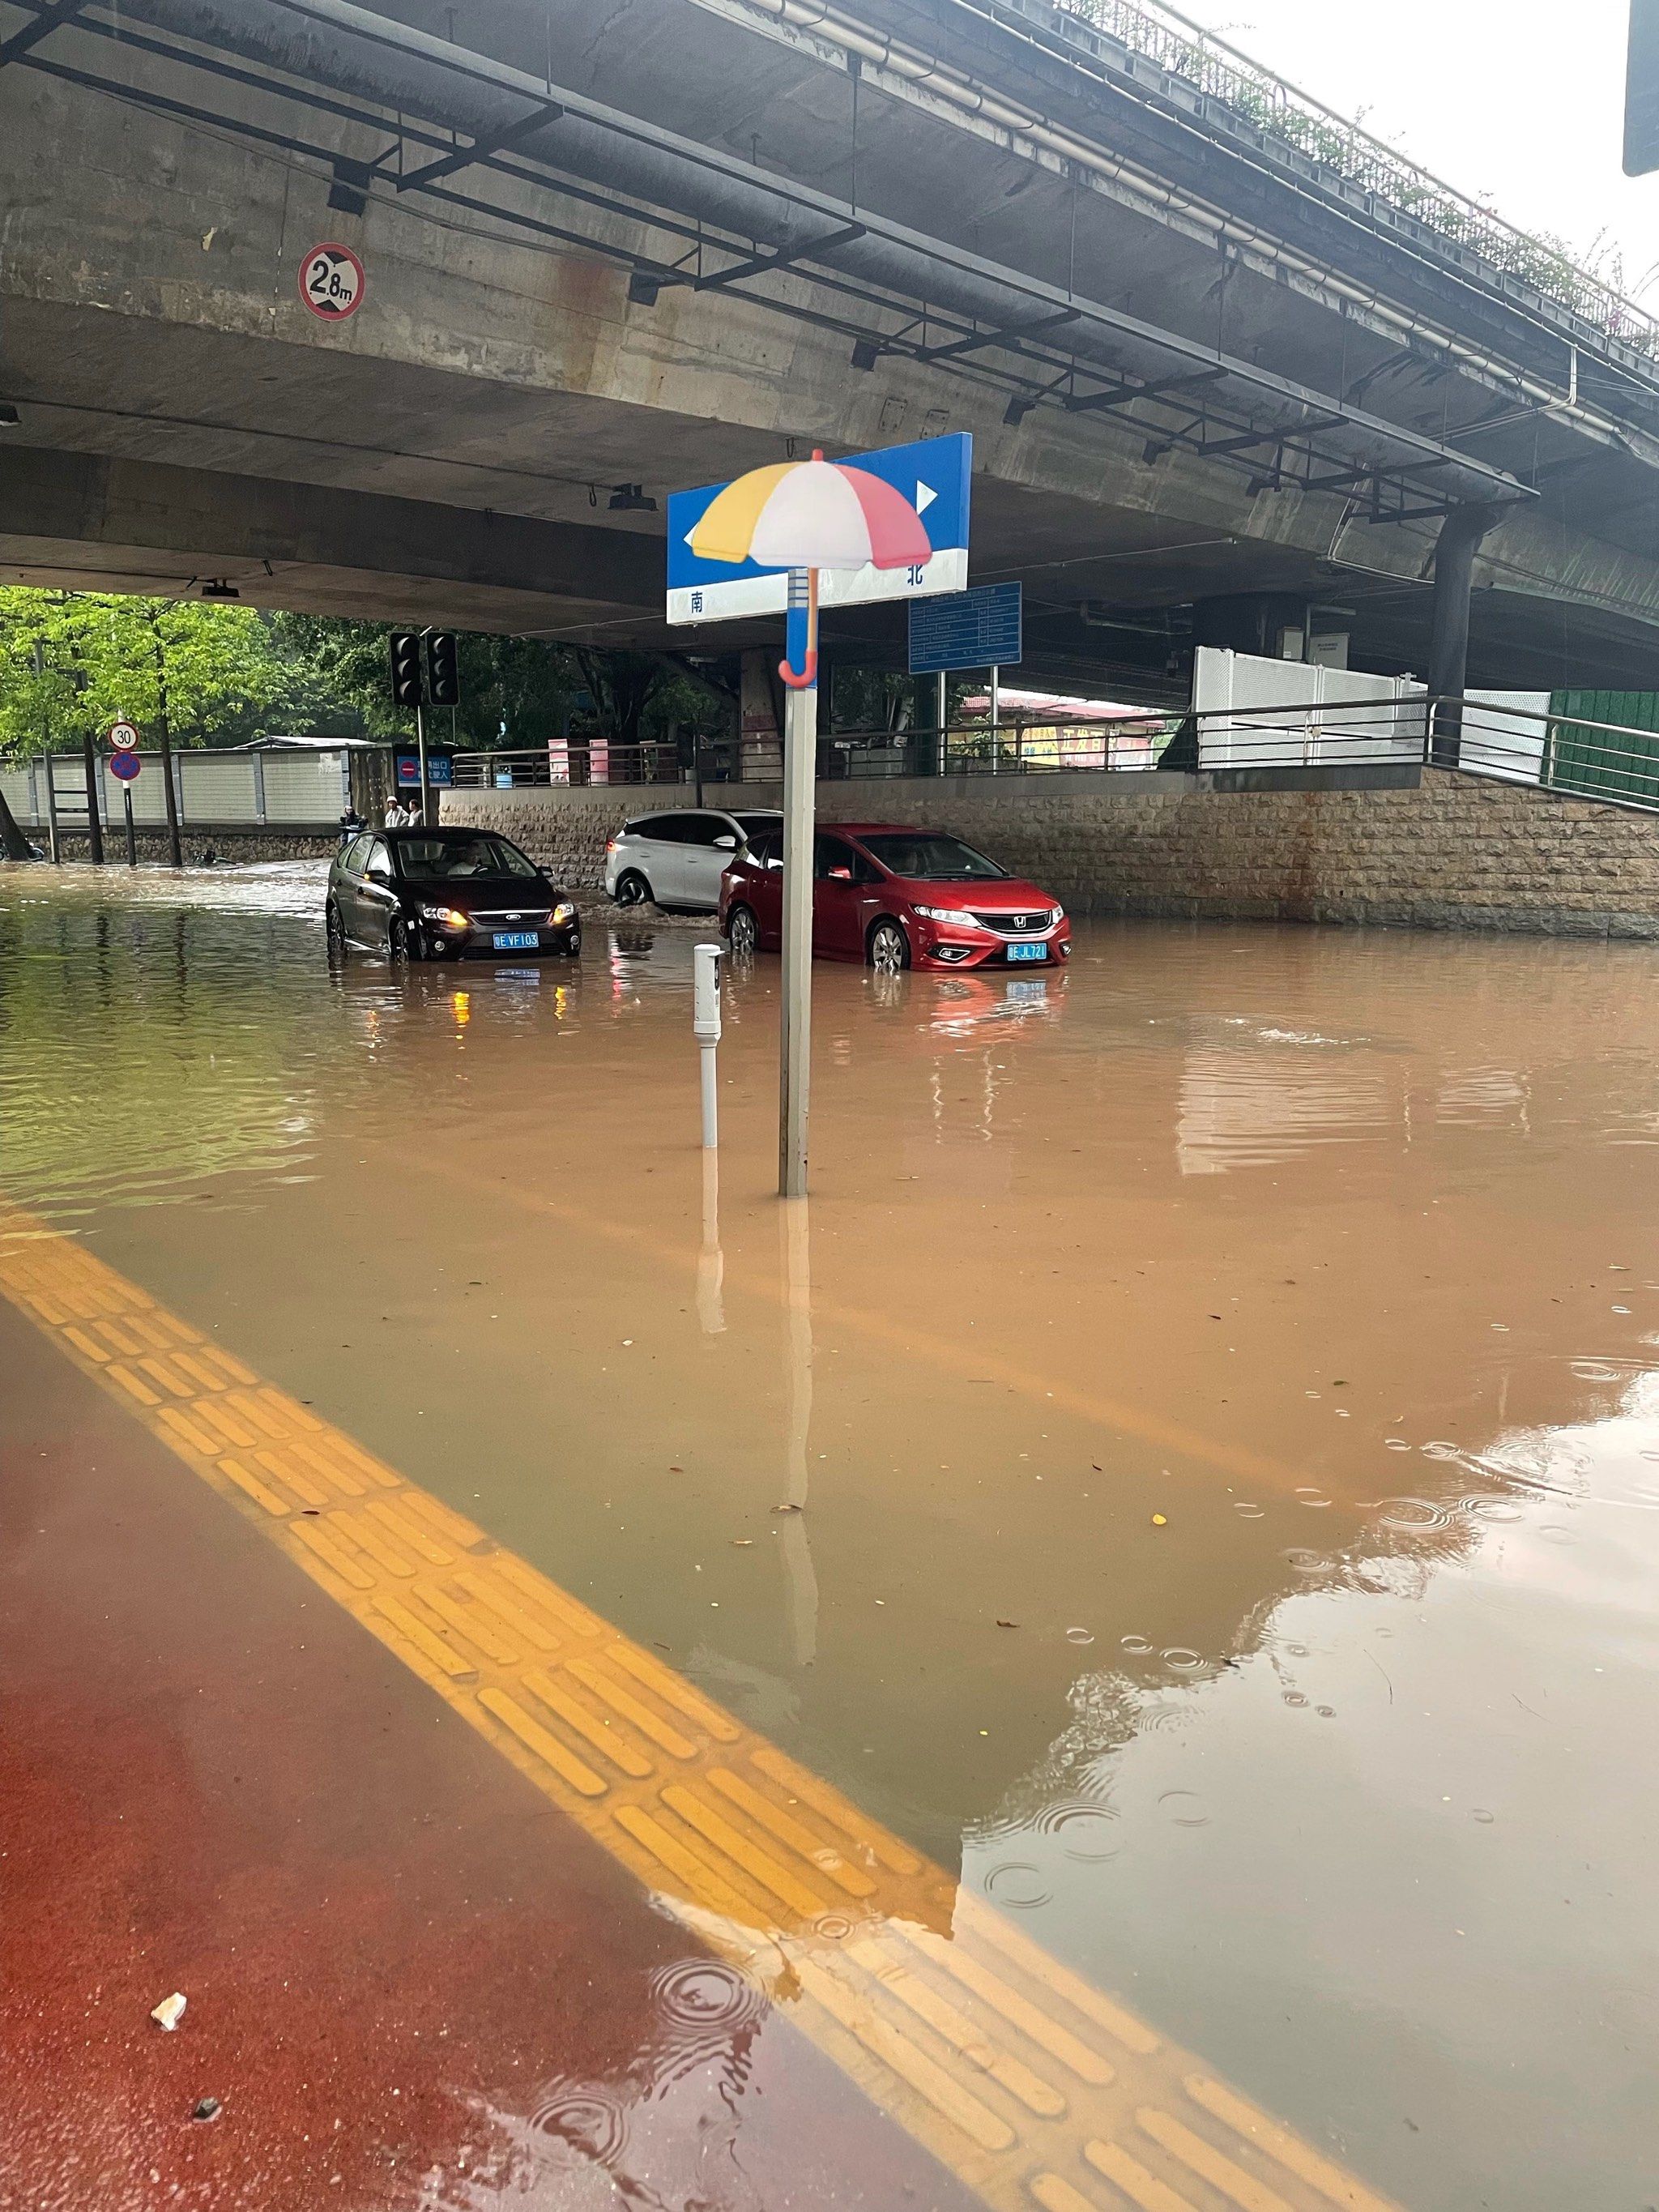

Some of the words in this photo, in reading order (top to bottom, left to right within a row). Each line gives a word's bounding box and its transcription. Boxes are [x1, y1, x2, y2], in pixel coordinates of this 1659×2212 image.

[907, 564, 923, 586] 北
[691, 591, 703, 613] 南
[117, 730, 131, 744] 30
